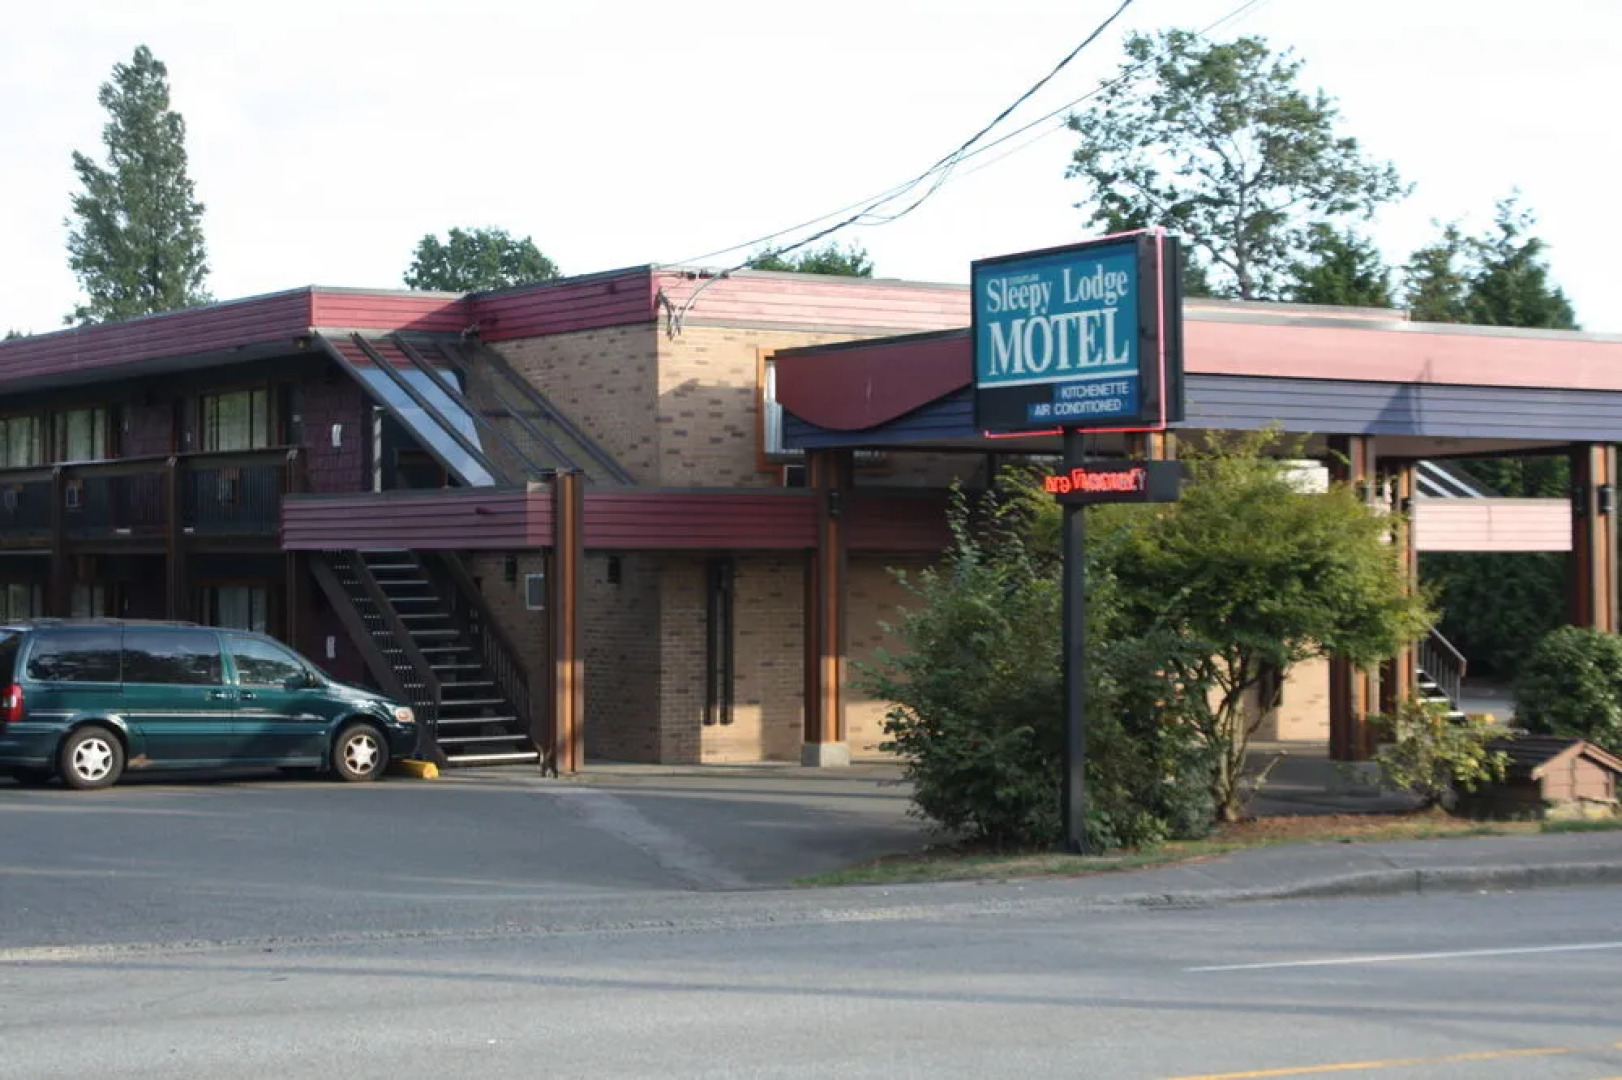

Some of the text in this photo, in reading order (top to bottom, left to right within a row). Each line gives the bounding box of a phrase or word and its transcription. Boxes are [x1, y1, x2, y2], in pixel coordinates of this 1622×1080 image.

[986, 264, 1128, 315] Sleepy Lodge
[988, 308, 1129, 376] MOTEL
[1061, 381, 1129, 399] KITCHENETTE
[1035, 399, 1121, 416] AIR CONDITIONED
